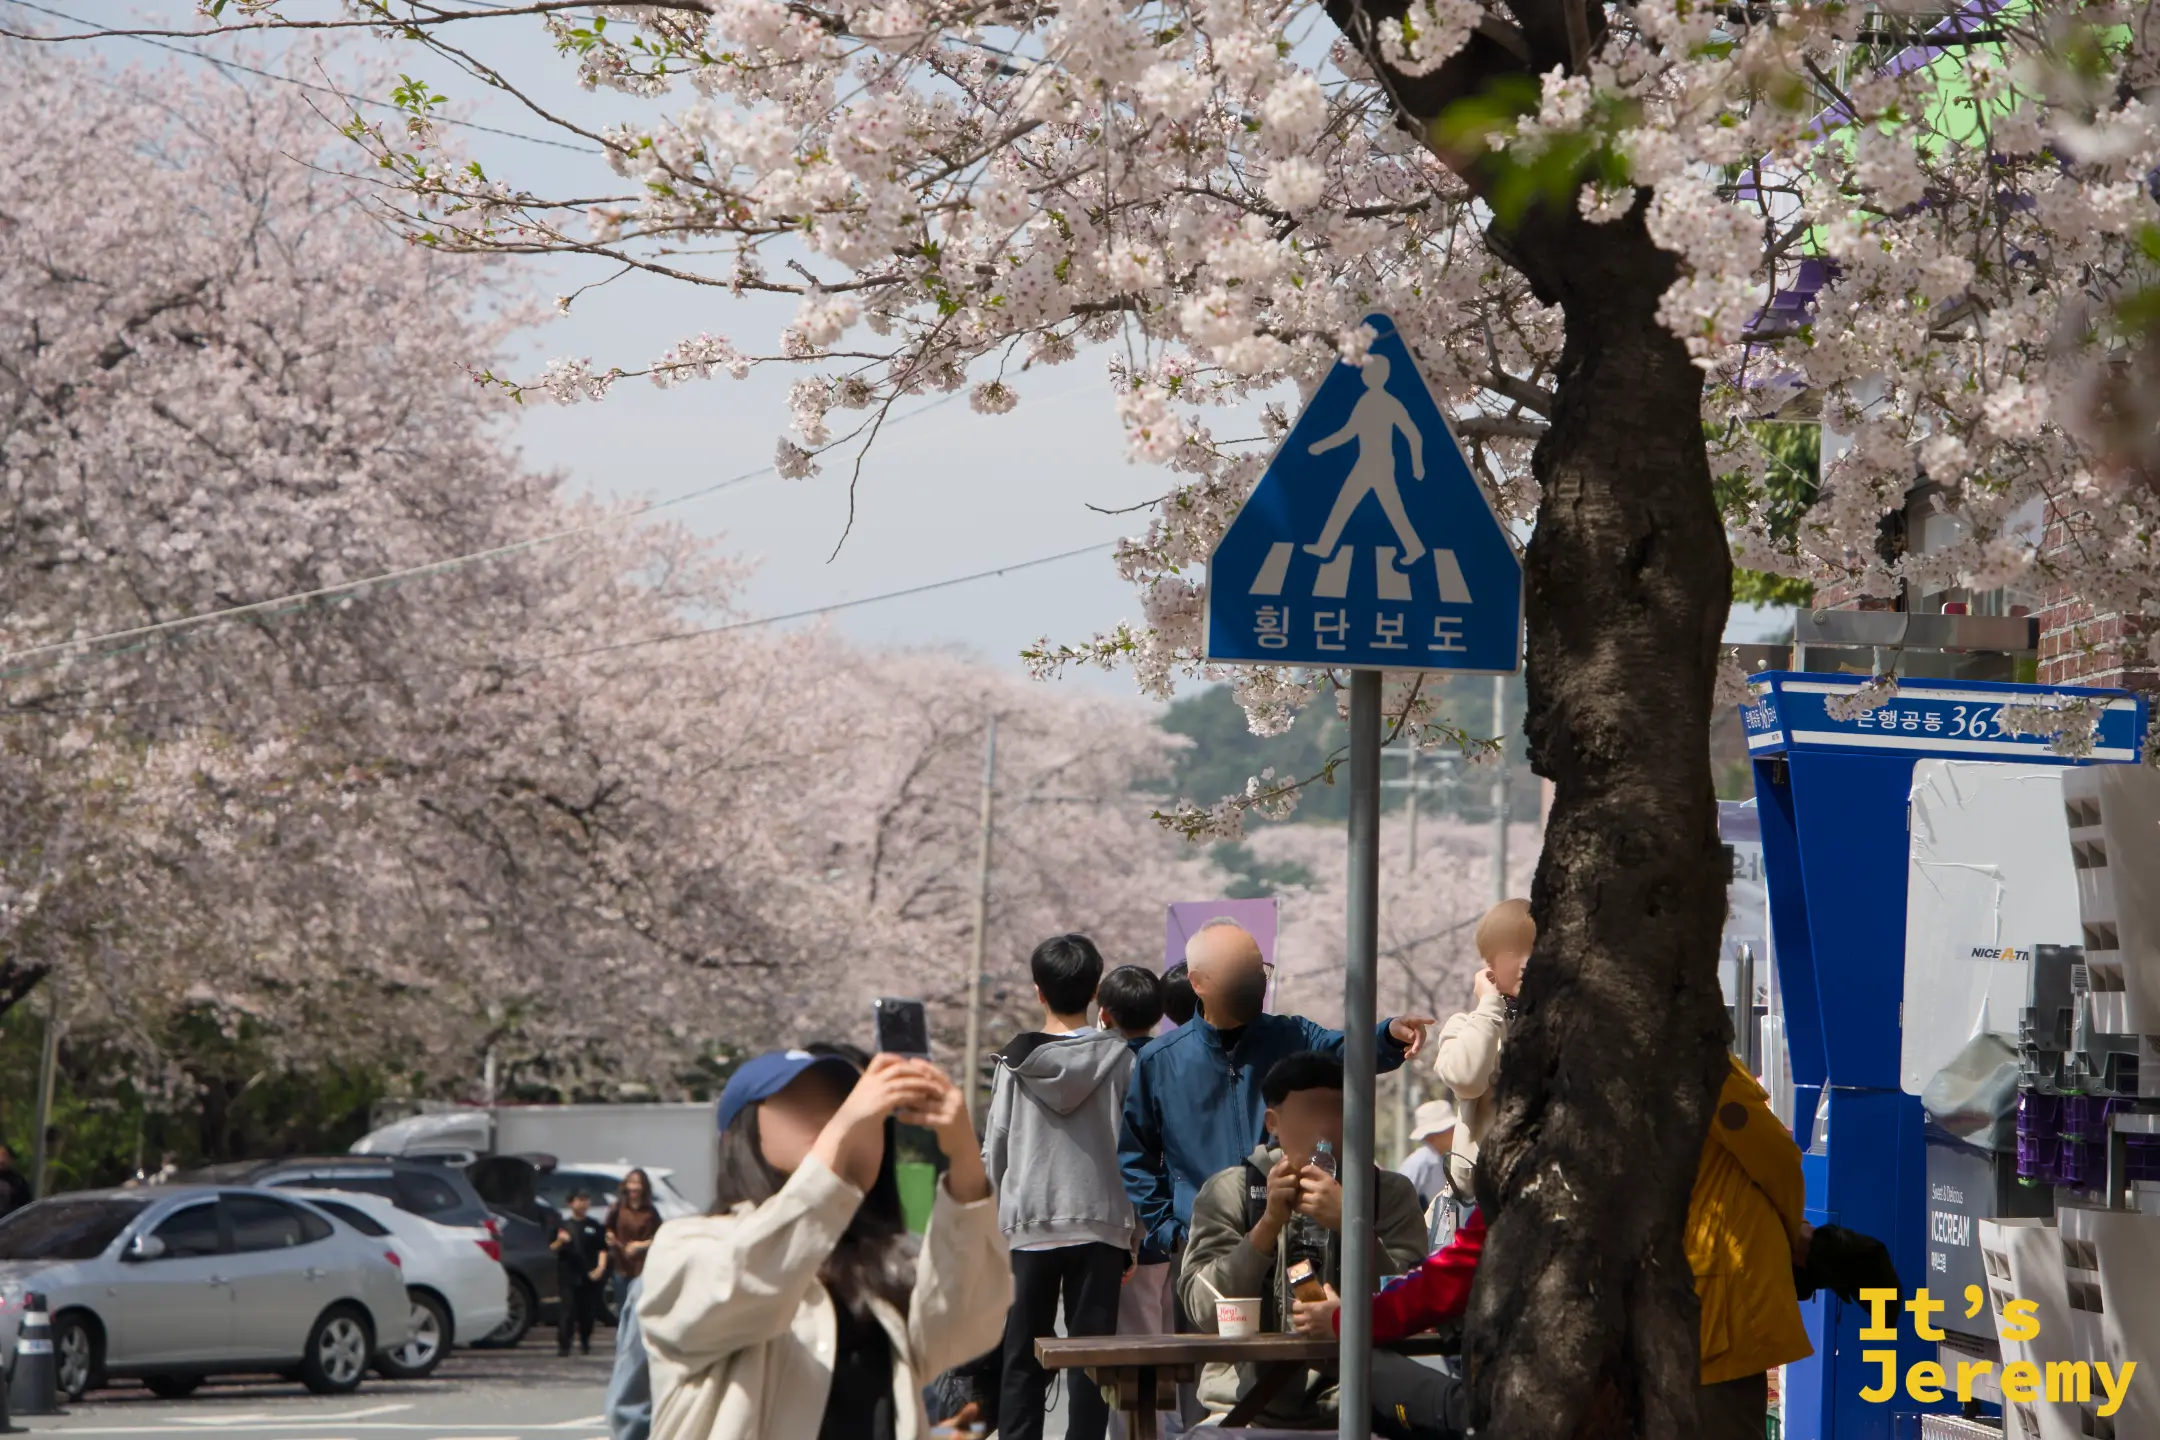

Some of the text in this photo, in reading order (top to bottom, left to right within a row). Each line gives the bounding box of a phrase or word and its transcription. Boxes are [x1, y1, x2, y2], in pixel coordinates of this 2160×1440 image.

[1253, 604, 1468, 652] 횡단보도
[1857, 708, 1944, 732] 은행공동
[1931, 1210, 1970, 1247] ICECREAM
